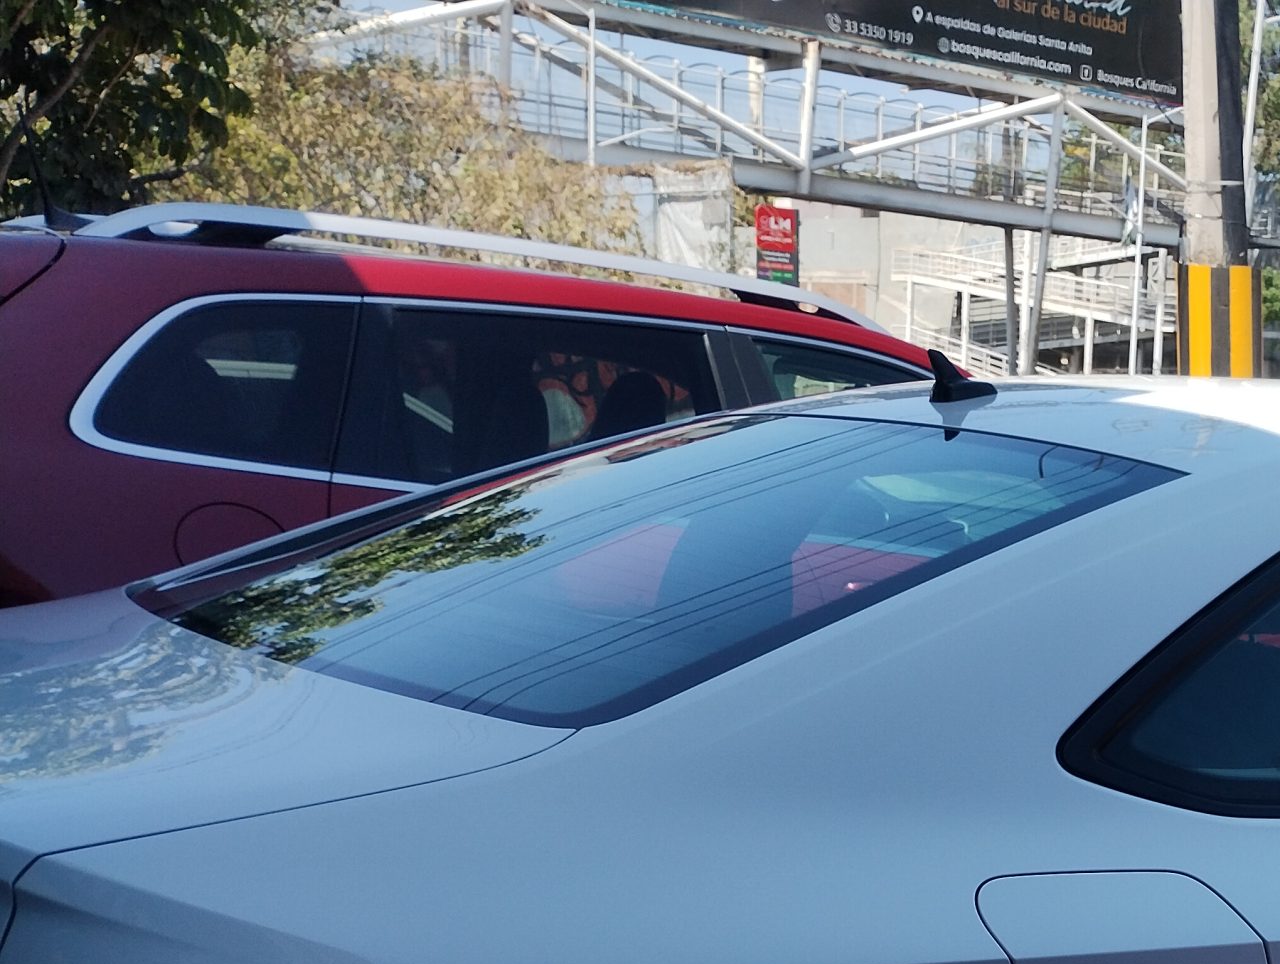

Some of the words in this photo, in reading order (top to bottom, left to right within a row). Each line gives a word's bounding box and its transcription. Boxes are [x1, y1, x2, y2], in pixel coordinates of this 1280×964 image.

[844, 20, 858, 34] 33
[887, 29, 914, 46] 1919
[925, 11, 934, 23] A
[982, 23, 996, 37] de
[1038, 34, 1067, 51] Santa
[1068, 41, 1093, 56] Anita
[1013, 0, 1038, 16] sur
[1040, 1, 1060, 20] de
[1063, 4, 1076, 24] la
[1079, 11, 1128, 35] ciudad
[951, 39, 1072, 74] bosquescalifornia.com
[1096, 69, 1134, 88] Bosques
[1135, 77, 1177, 96] California
